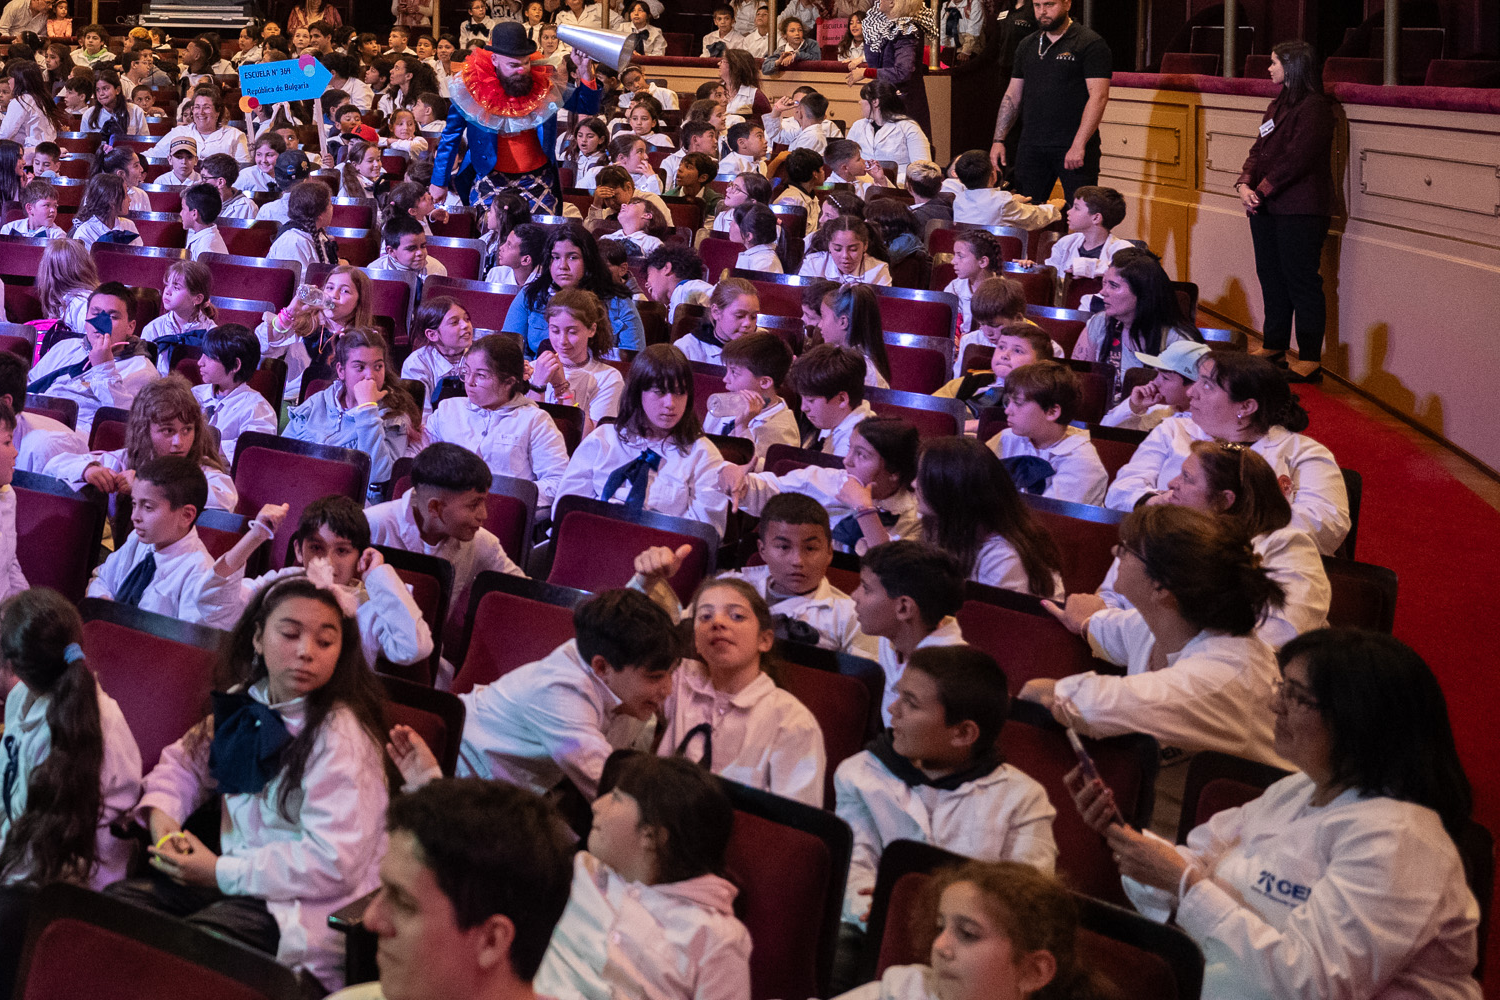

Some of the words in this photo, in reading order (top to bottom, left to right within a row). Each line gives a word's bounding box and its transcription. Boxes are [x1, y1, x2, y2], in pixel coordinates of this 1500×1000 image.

[244, 69, 271, 79] ESCUELA
[246, 85, 275, 96] República
[276, 84, 283, 92] de
[284, 81, 310, 92] Bulgaria
